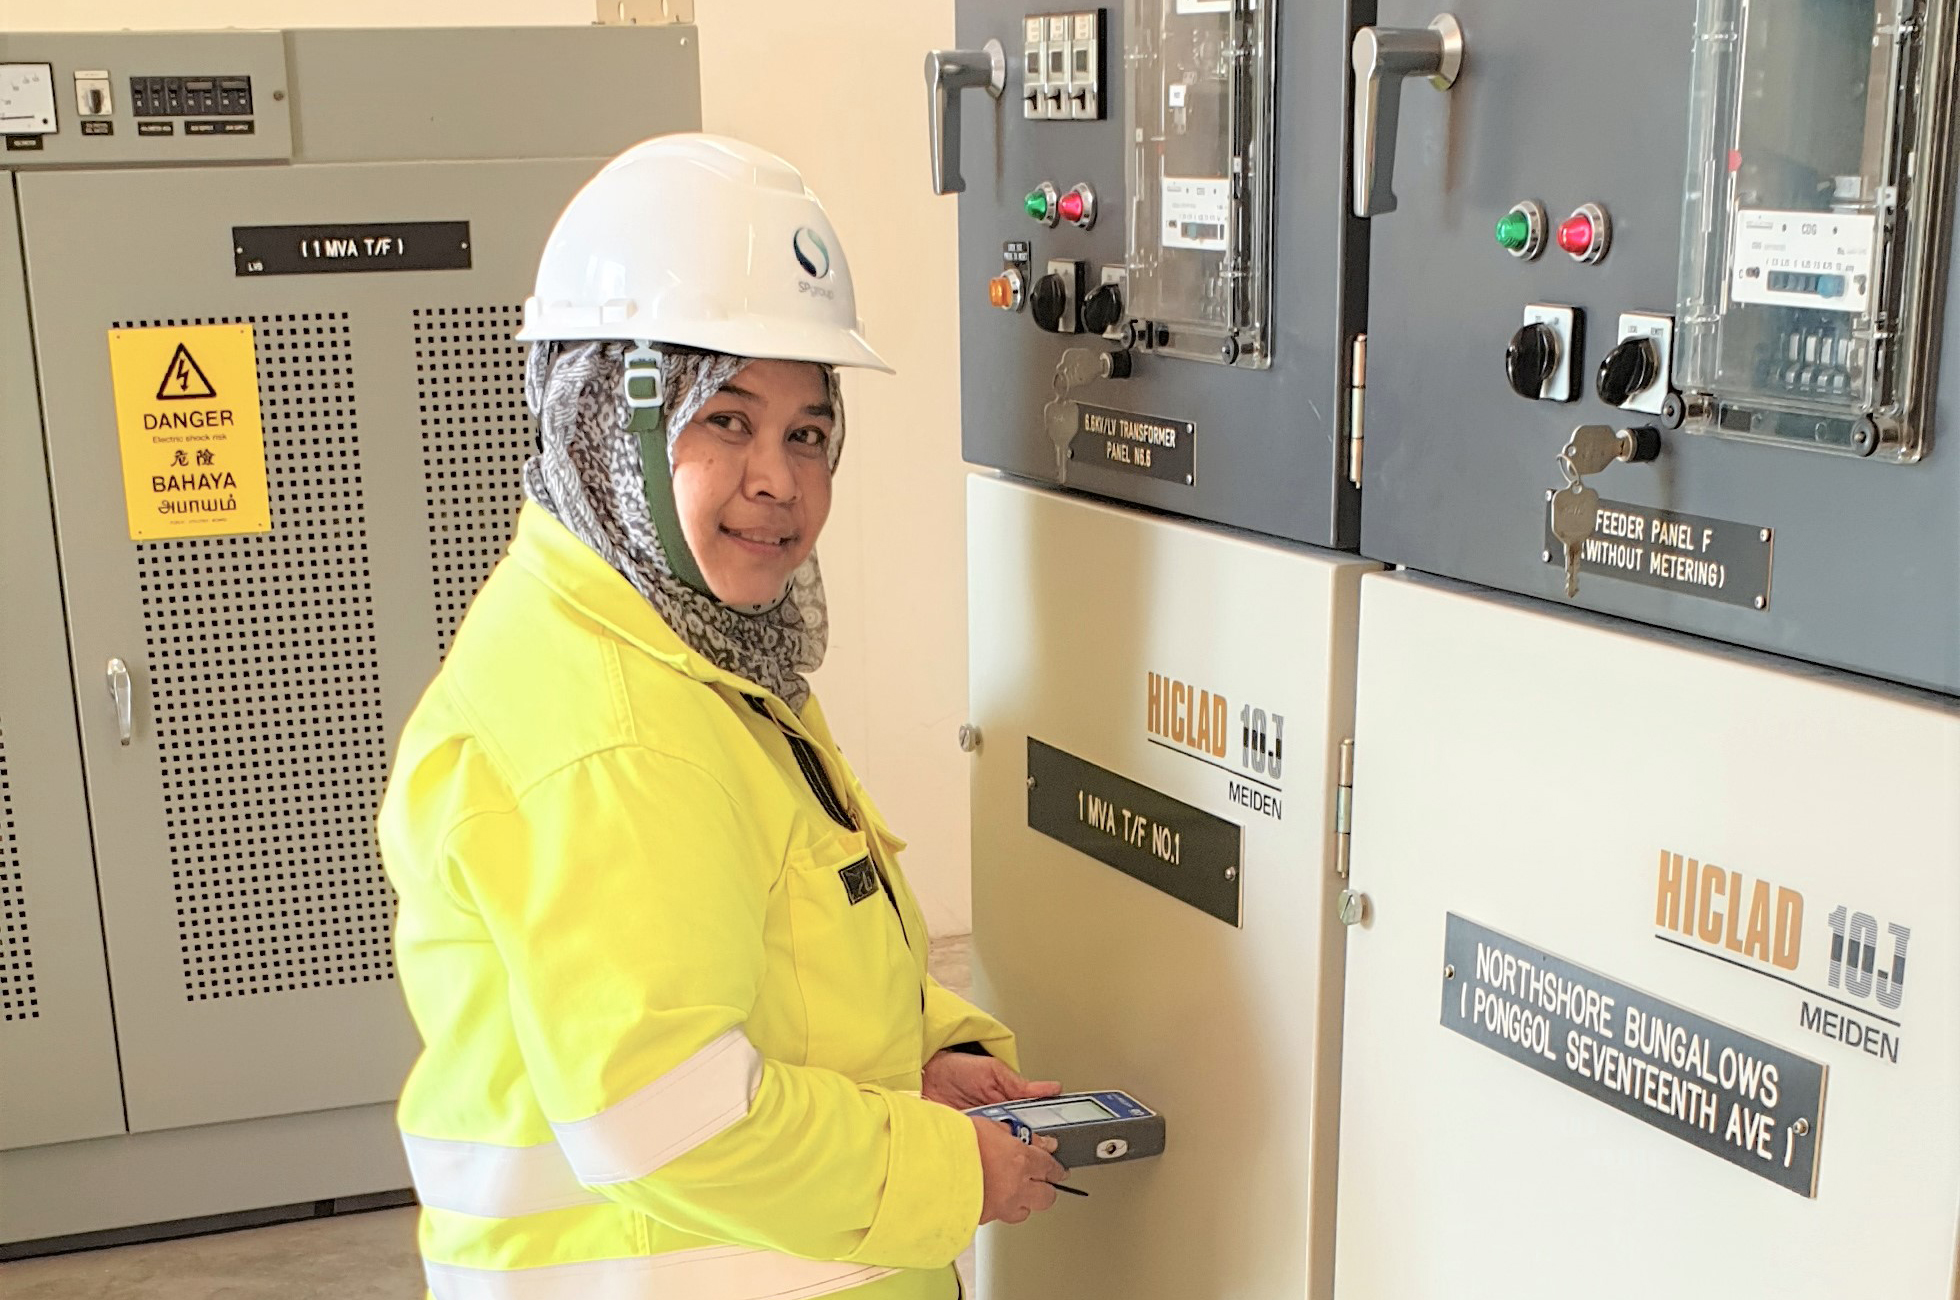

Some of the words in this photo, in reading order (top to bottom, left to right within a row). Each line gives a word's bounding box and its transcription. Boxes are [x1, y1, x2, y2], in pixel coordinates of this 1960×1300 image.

[325, 239, 359, 258] MVA
[363, 237, 392, 257] T/F
[144, 411, 234, 429] DANGER
[152, 435, 184, 443] Electric
[185, 434, 210, 442] shock
[1120, 420, 1176, 448] TRANSFORMER
[1106, 441, 1131, 464] PANEL
[152, 471, 237, 493] BAHAYA
[158, 494, 236, 513] அபாயம்
[1594, 509, 1644, 541] FEEDER
[1650, 519, 1695, 551] PANEL
[1701, 528, 1713, 553] F
[1649, 551, 1726, 589] METERING)
[1147, 671, 1228, 759] HICLAD
[1239, 703, 1285, 780] 10J
[1228, 780, 1282, 821] MEIDEN
[1078, 789, 1084, 822] 1
[1088, 794, 1116, 836] MVA
[1121, 808, 1147, 848] T/F
[1152, 822, 1180, 866] NO.1
[1655, 848, 1805, 972] HICLAD
[1827, 905, 1911, 1011] 10J
[1475, 942, 1615, 1039] NORTHSHORE
[1624, 1009, 1779, 1109] BUNGALOWS
[1799, 1000, 1900, 1065] MEIDEN
[1473, 987, 1556, 1061] PONGGOL
[1565, 1030, 1717, 1135] SEVENTEENTH
[1724, 1102, 1773, 1160] AVE
